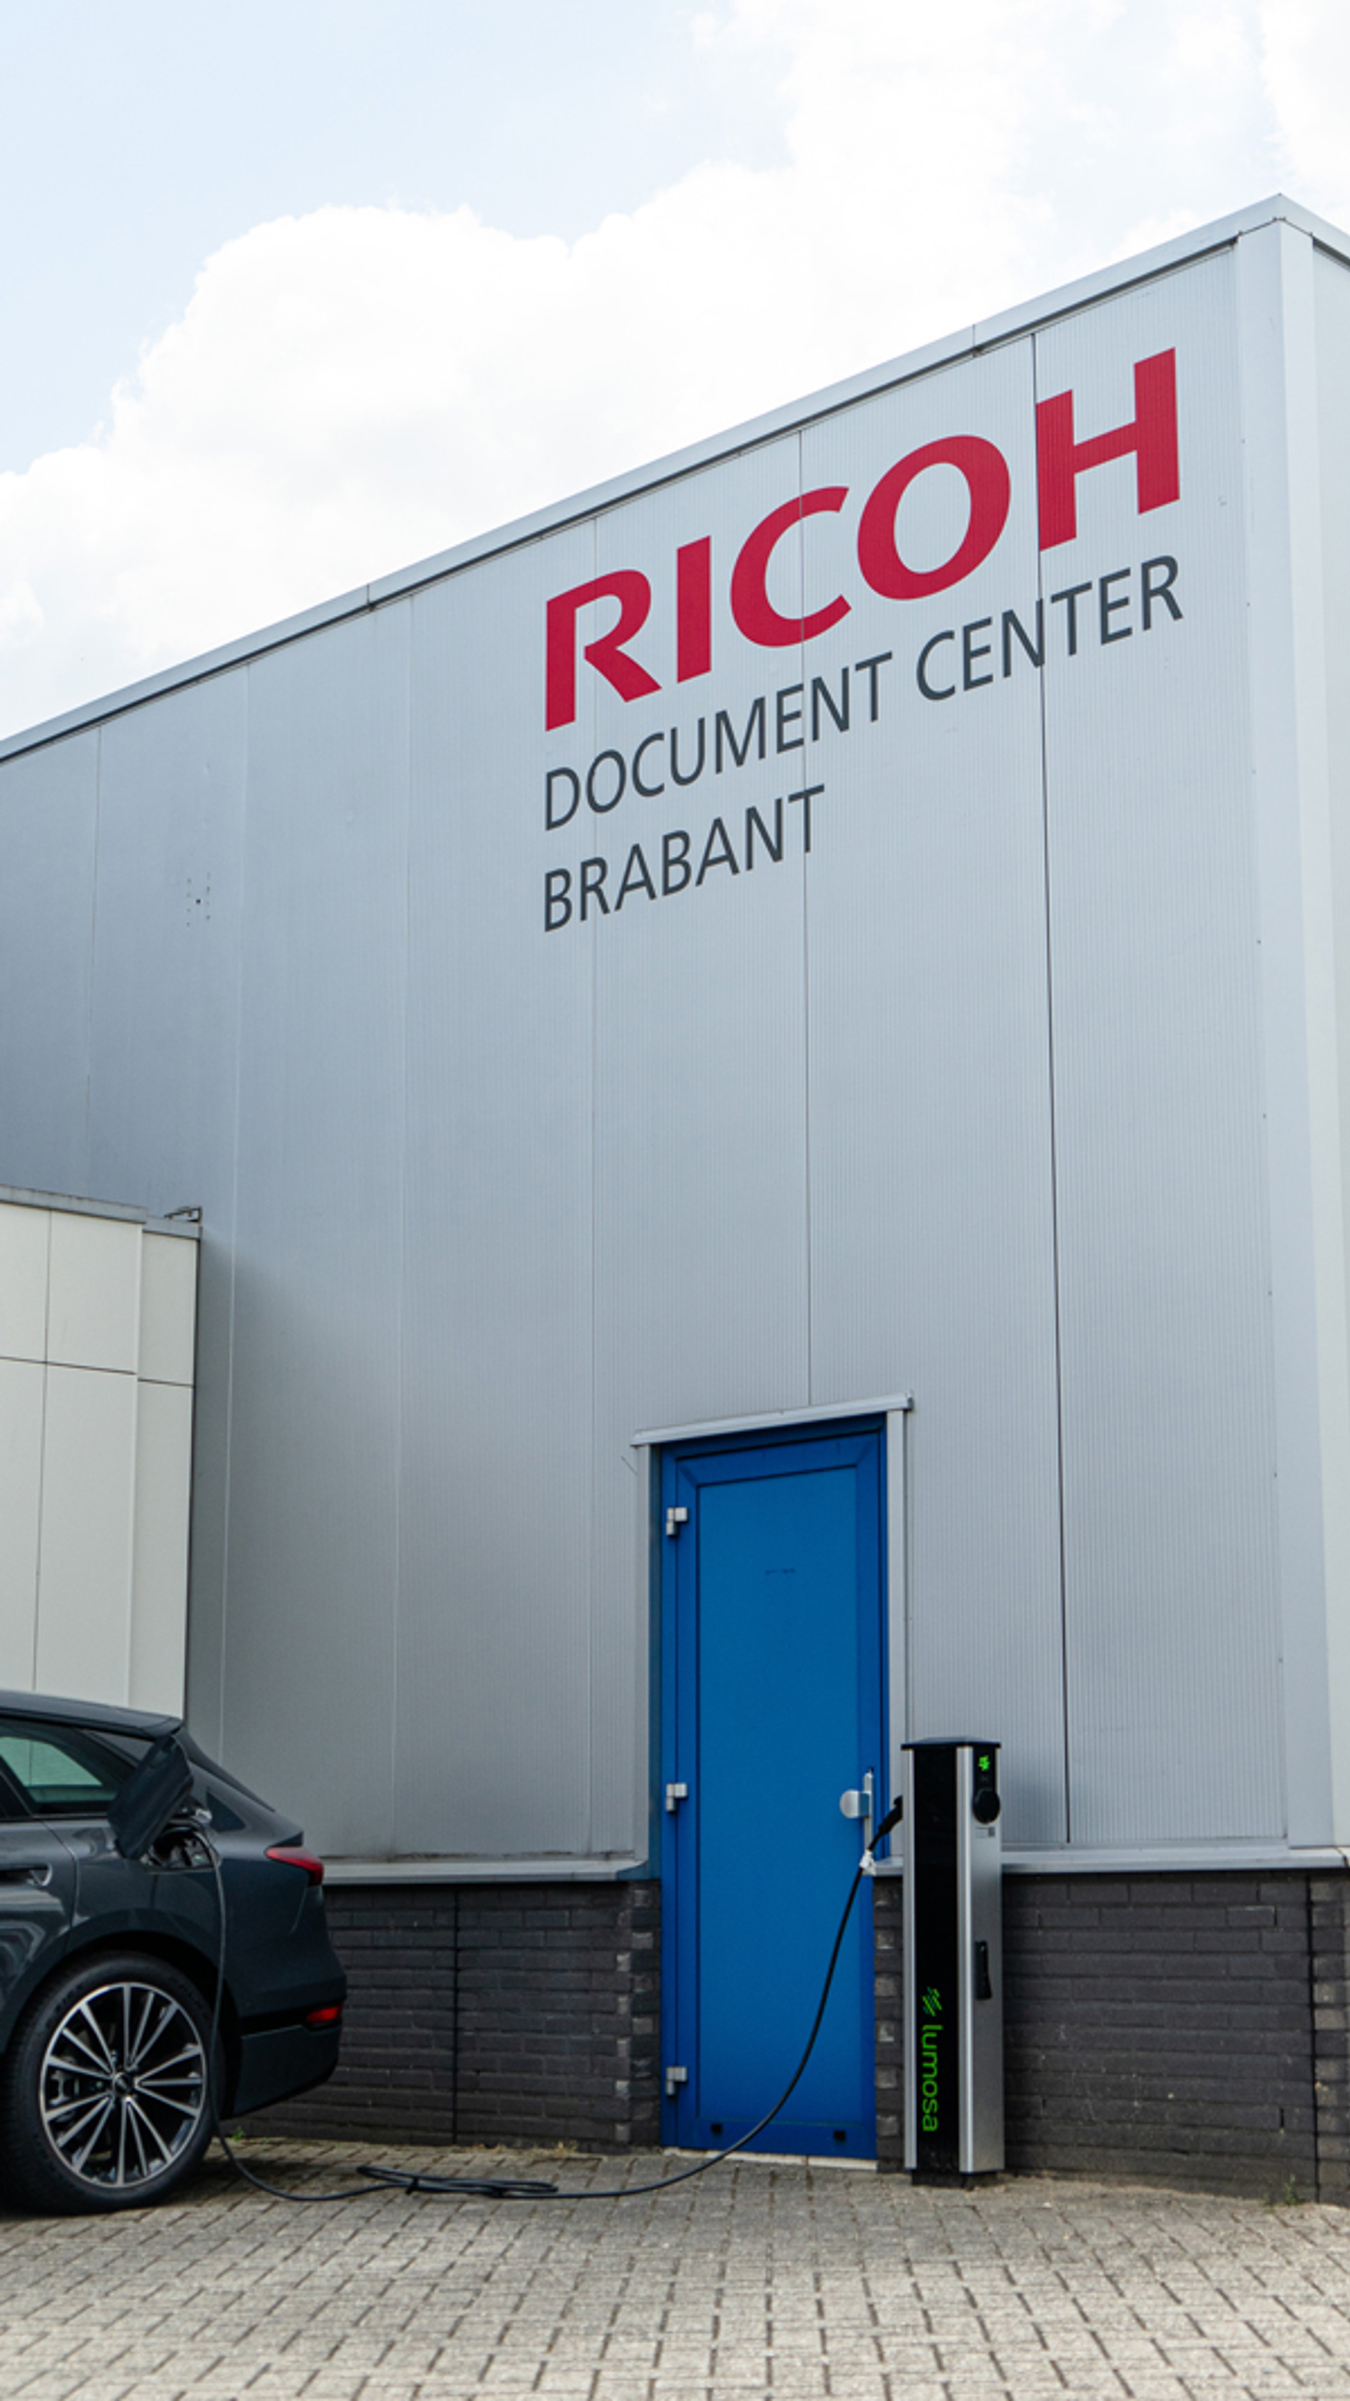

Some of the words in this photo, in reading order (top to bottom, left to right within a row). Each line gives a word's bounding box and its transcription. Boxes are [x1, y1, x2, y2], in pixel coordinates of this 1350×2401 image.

[545, 347, 1181, 732] RICOH
[545, 651, 893, 832] DOCUMENT
[916, 555, 1184, 701] CENTER
[544, 784, 825, 932] BRABANT
[922, 2024, 943, 2132] lumosa
